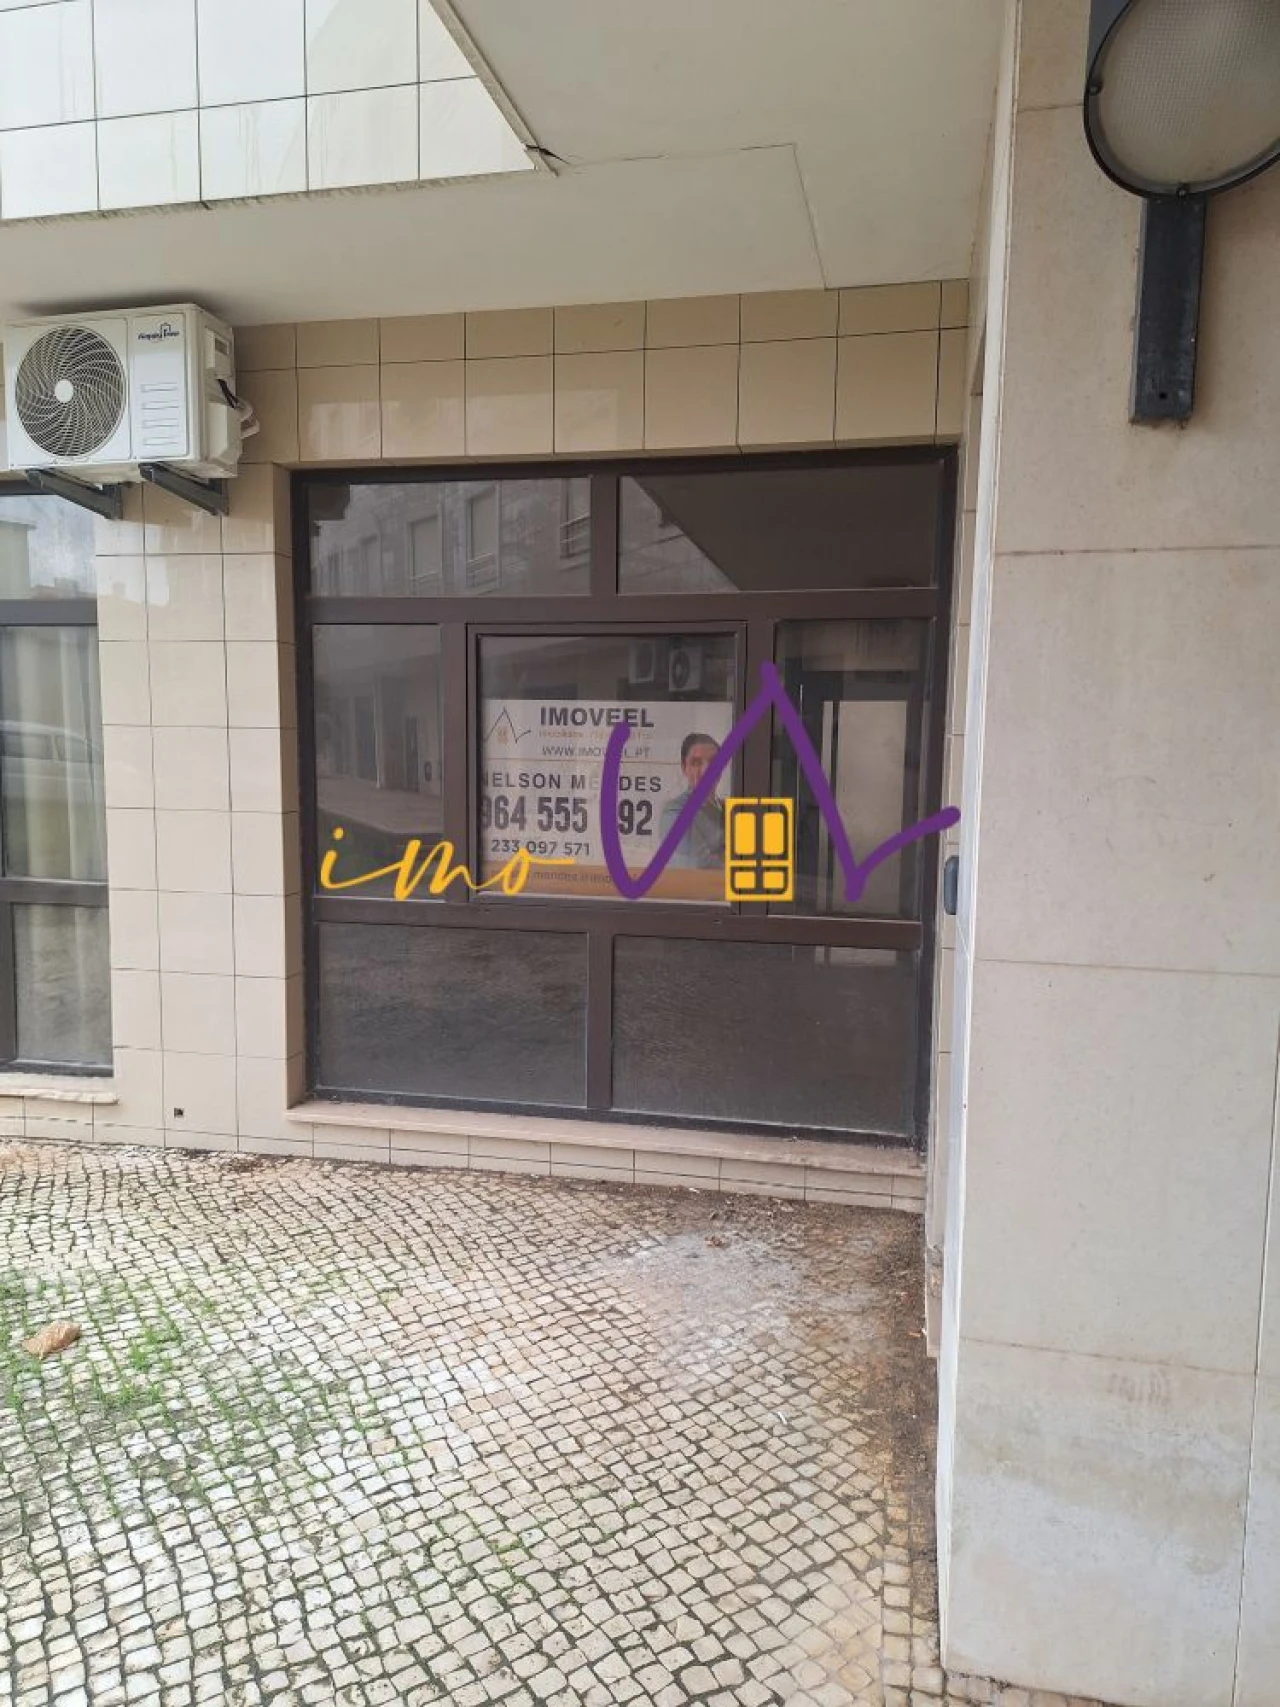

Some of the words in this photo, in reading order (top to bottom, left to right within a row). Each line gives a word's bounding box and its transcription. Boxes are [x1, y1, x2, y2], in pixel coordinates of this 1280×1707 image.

[540, 706, 655, 728] IMOVEEL
[571, 774, 662, 792] MEDES
[537, 796, 588, 834] 555
[605, 799, 652, 836] 92
[491, 839, 520, 853] 233
[526, 840, 558, 855] 097
[564, 842, 590, 857] 571
